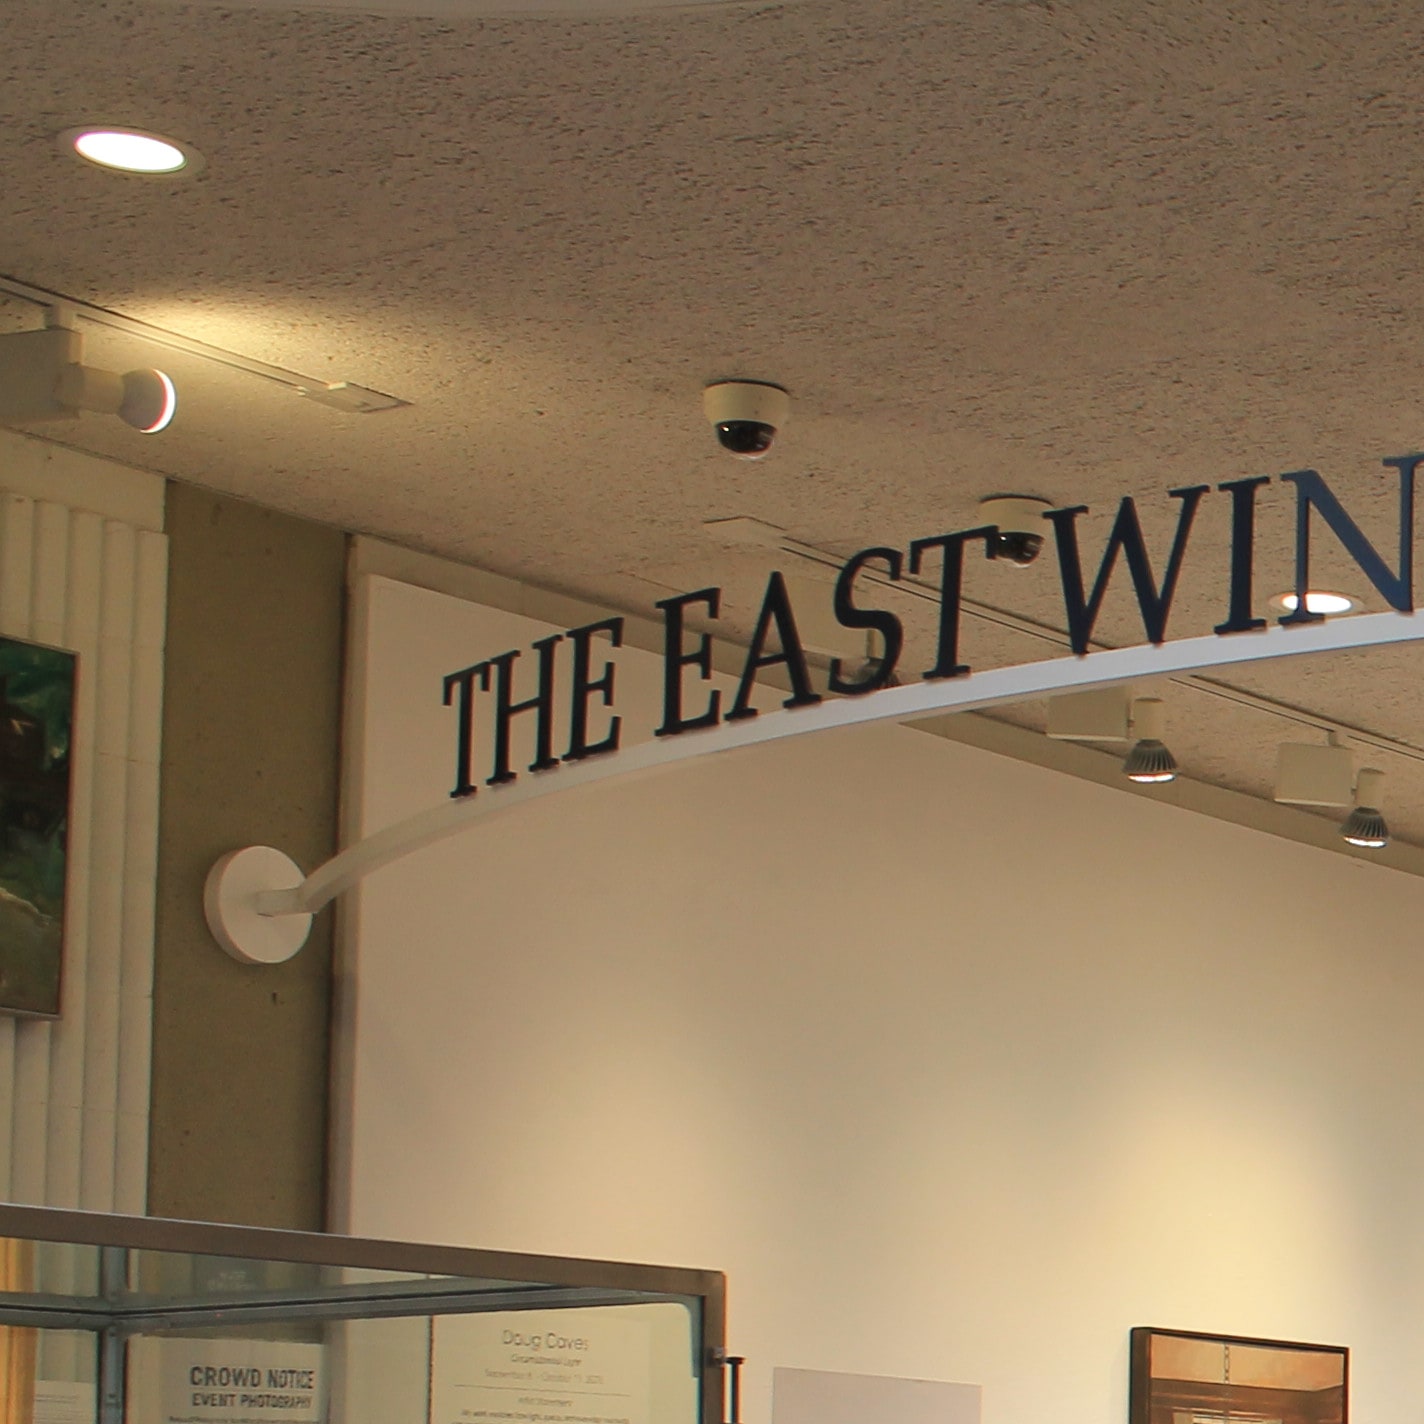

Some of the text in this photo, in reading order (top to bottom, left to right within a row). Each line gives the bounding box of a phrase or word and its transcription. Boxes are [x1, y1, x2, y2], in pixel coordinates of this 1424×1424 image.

[442, 616, 624, 800] THE
[652, 526, 1000, 738] EAST
[190, 1366, 314, 1389] CROWD NOTICE
[192, 1392, 236, 1407] EVENT
